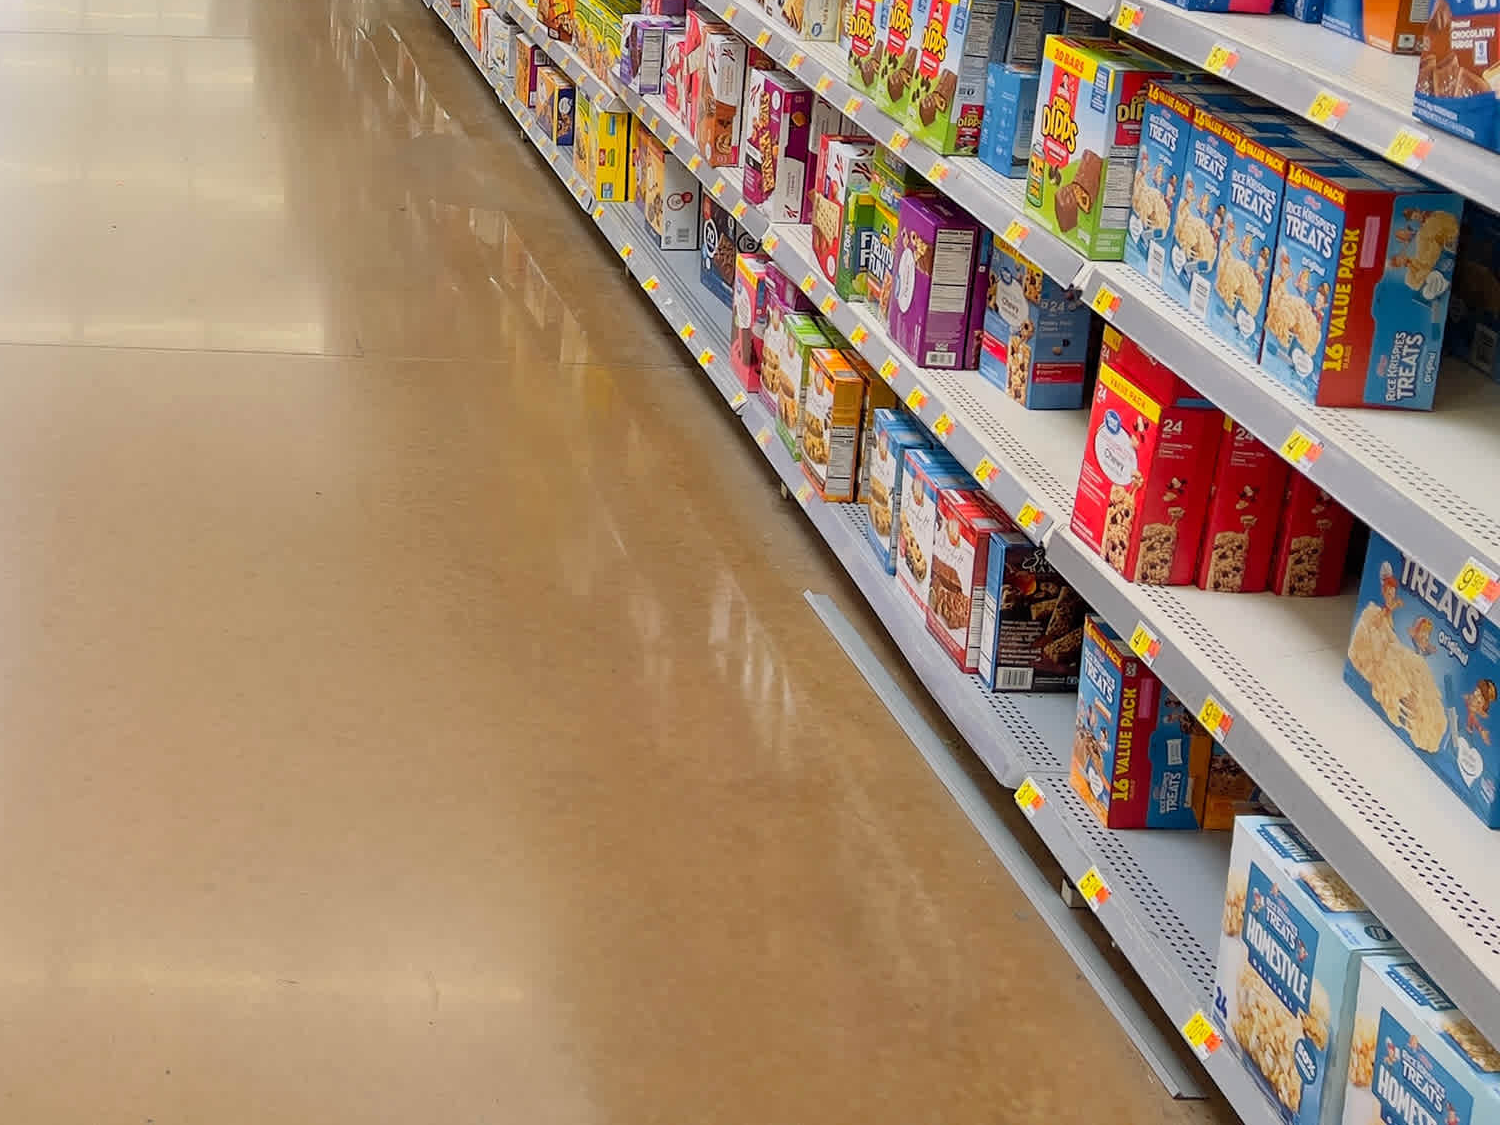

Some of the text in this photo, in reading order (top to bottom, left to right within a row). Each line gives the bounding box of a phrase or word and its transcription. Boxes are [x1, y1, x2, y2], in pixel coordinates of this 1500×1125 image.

[1451, 27, 1495, 39] CHOCOLATEY
[1451, 39, 1474, 49] FUDGE
[1064, 52, 1084, 73] BARS
[1194, 151, 1225, 181] TREATS
[1231, 184, 1272, 225] TREATS
[1286, 201, 1337, 238] RICE KRISPIES
[1285, 217, 1332, 259] TREATS
[1050, 301, 1064, 314] 24
[1323, 228, 1360, 371] 16 VALUE PACK
[1397, 333, 1423, 402] TREATS
[1163, 419, 1183, 433] 24
[1401, 554, 1480, 645] TREATS
[1083, 657, 1116, 703] TREATS
[1112, 688, 1137, 801] 16 VALUE PACK
[1167, 772, 1181, 811] TREATS
[1246, 914, 1309, 1006] HOMESTYLE
